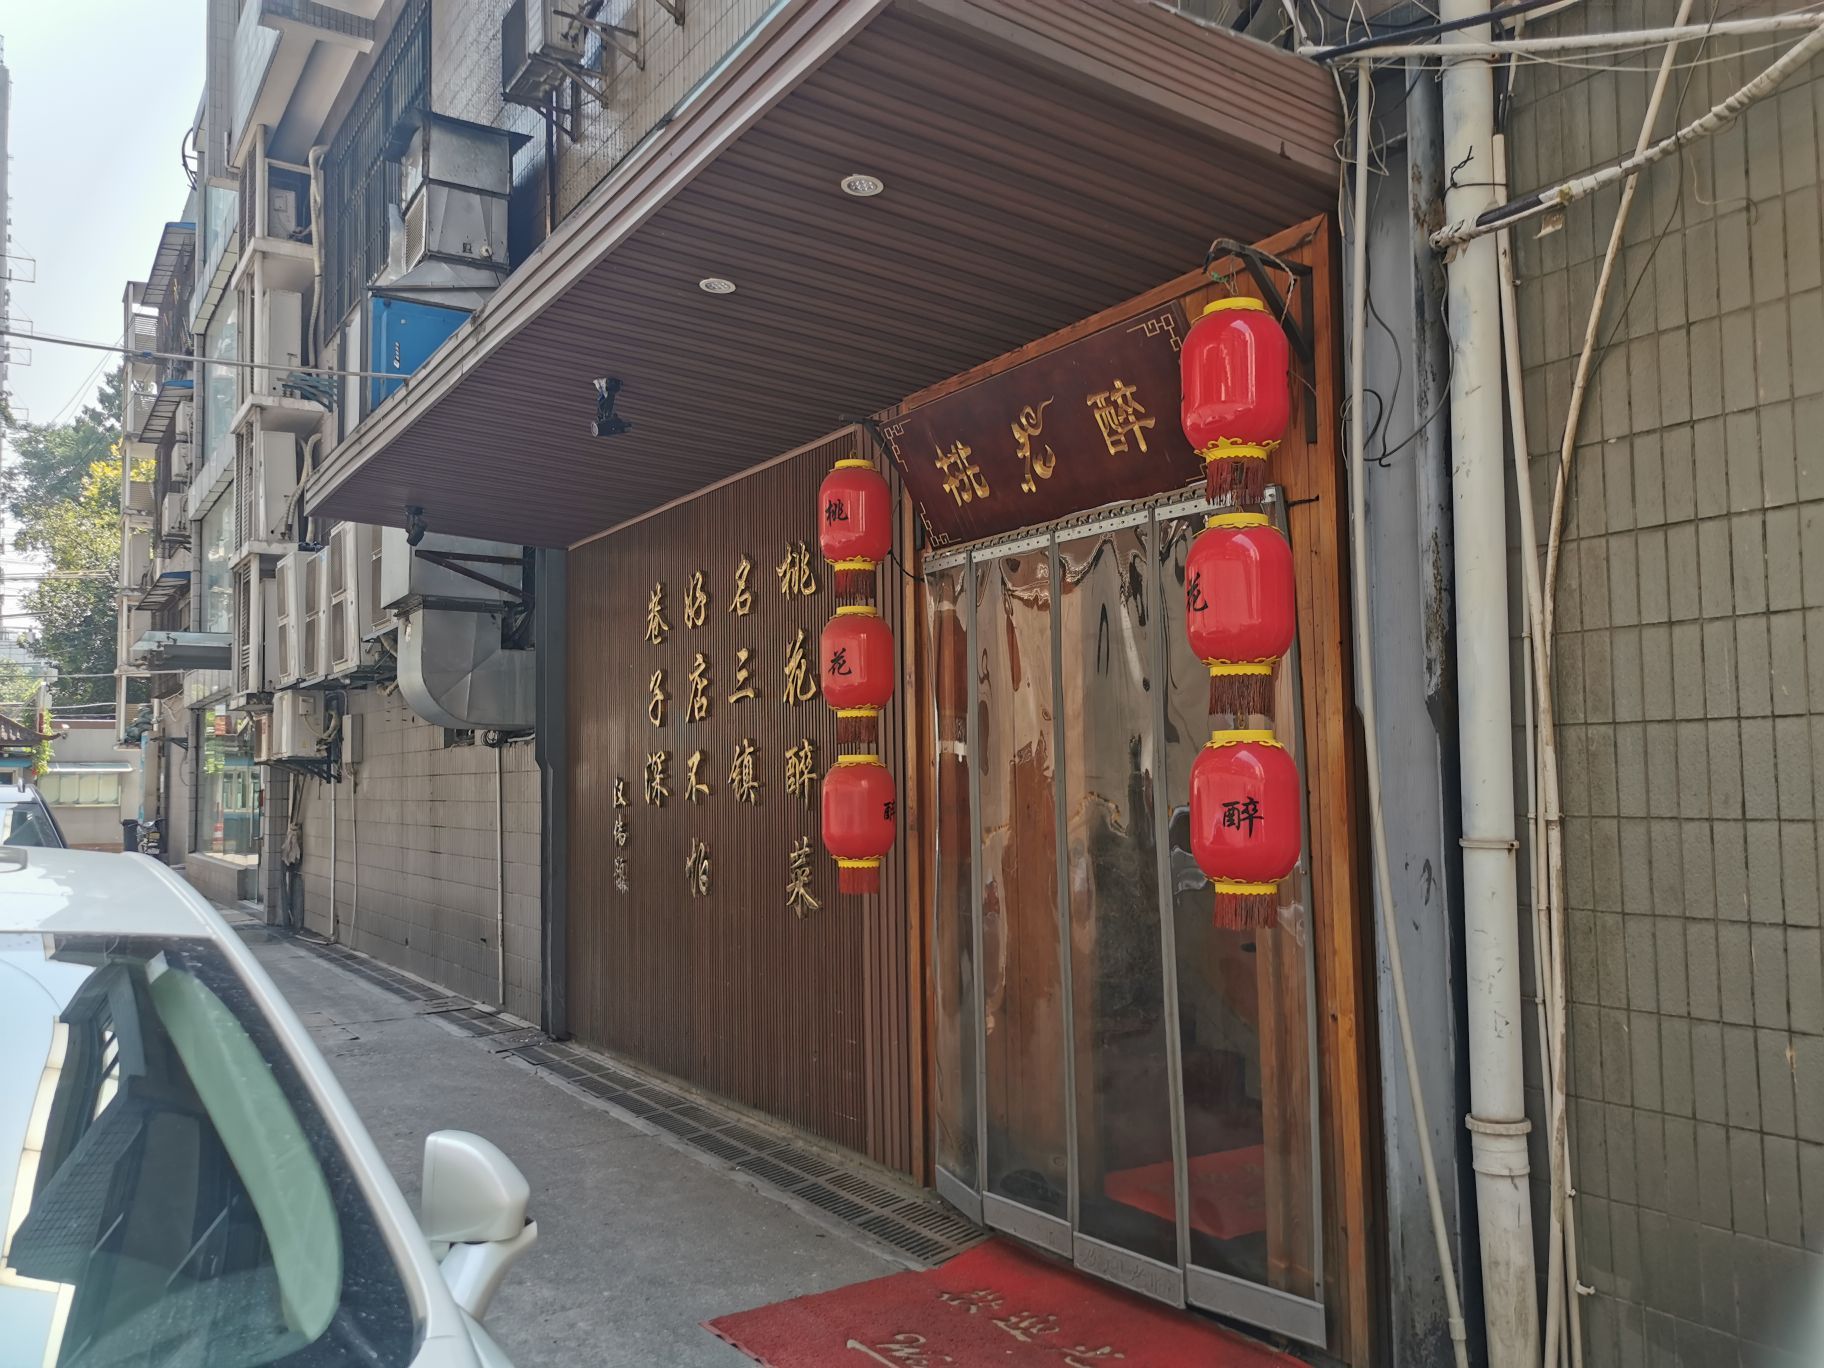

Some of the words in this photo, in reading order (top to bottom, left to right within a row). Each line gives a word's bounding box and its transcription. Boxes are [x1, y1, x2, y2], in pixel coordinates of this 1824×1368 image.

[824, 499, 849, 528] 桃
[827, 646, 853, 677] 花
[1222, 796, 1264, 839] 醉
